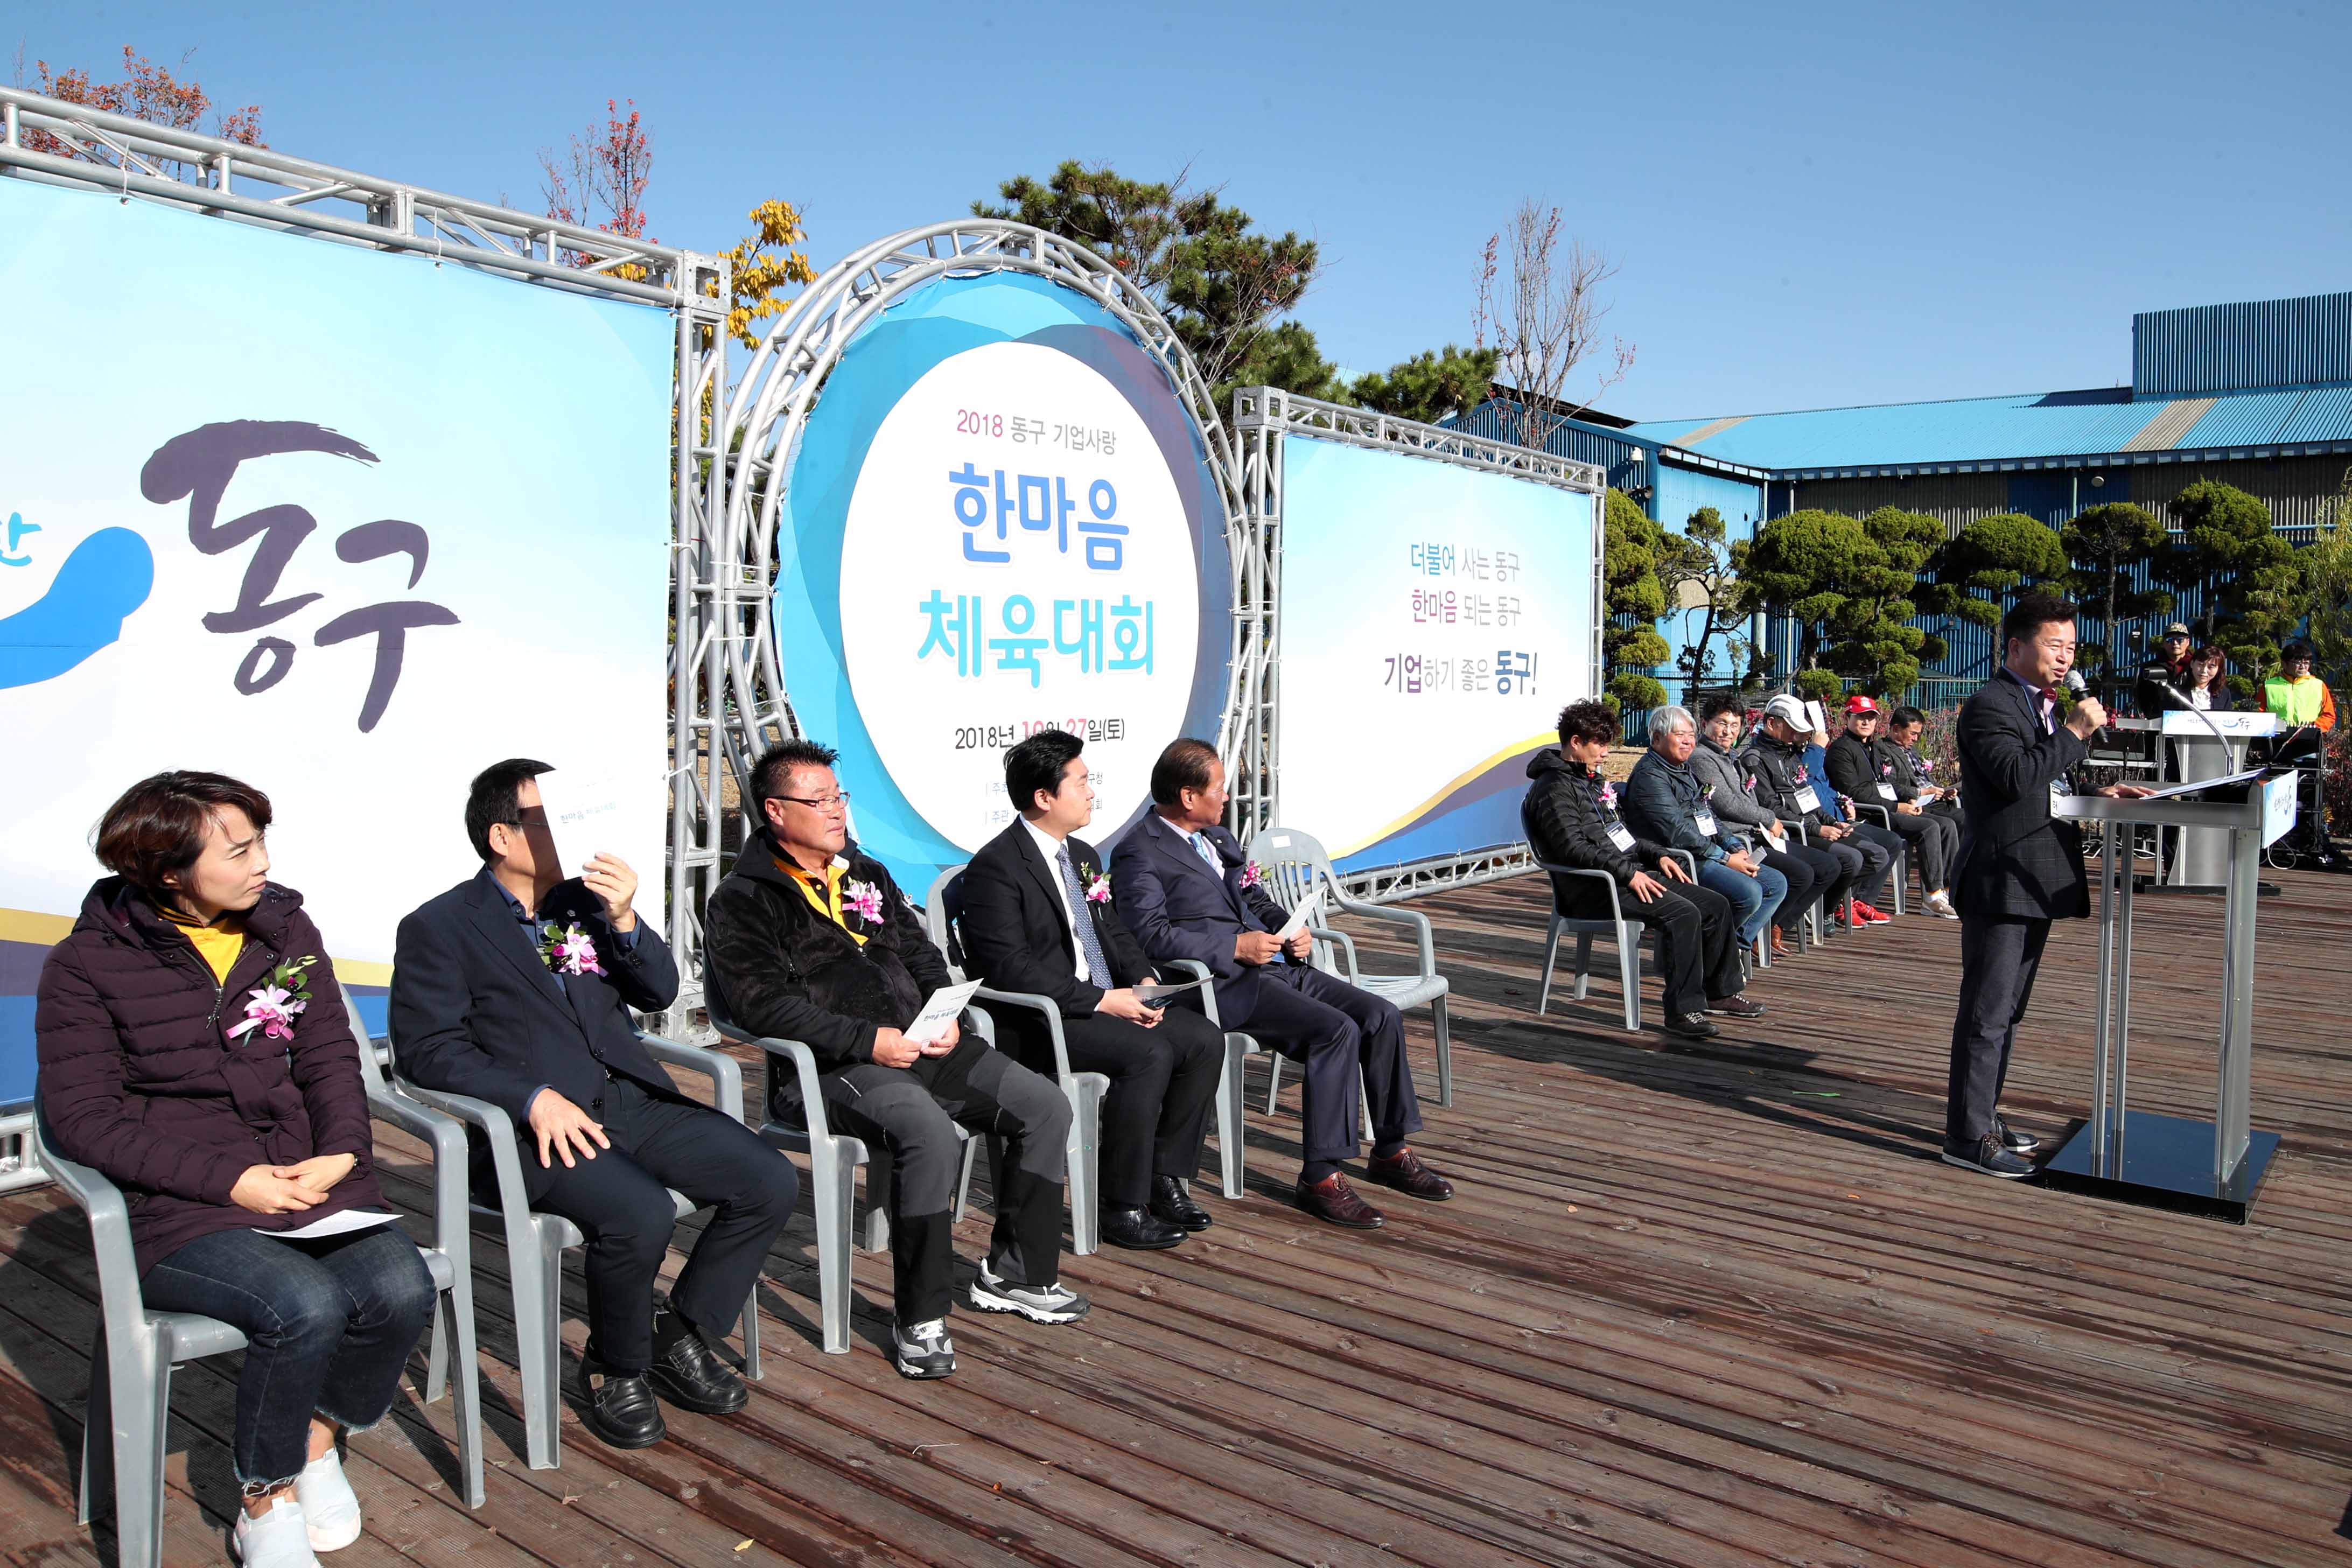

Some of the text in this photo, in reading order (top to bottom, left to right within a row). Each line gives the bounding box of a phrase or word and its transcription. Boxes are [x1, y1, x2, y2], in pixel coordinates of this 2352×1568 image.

[957, 409, 1116, 456] 2018 동구 기업사랑
[949, 462, 1129, 570] 한마음
[141, 419, 461, 733] 동구
[1411, 542, 1520, 582] 더불어 사는 동구
[1411, 589, 1521, 626] 한마음 되는 동구
[917, 590, 1153, 689] 체육대회
[1384, 650, 1537, 695] 기업하기 좋은 동구!
[955, 724, 1014, 749] 2018년
[991, 809, 1010, 824] 주관
